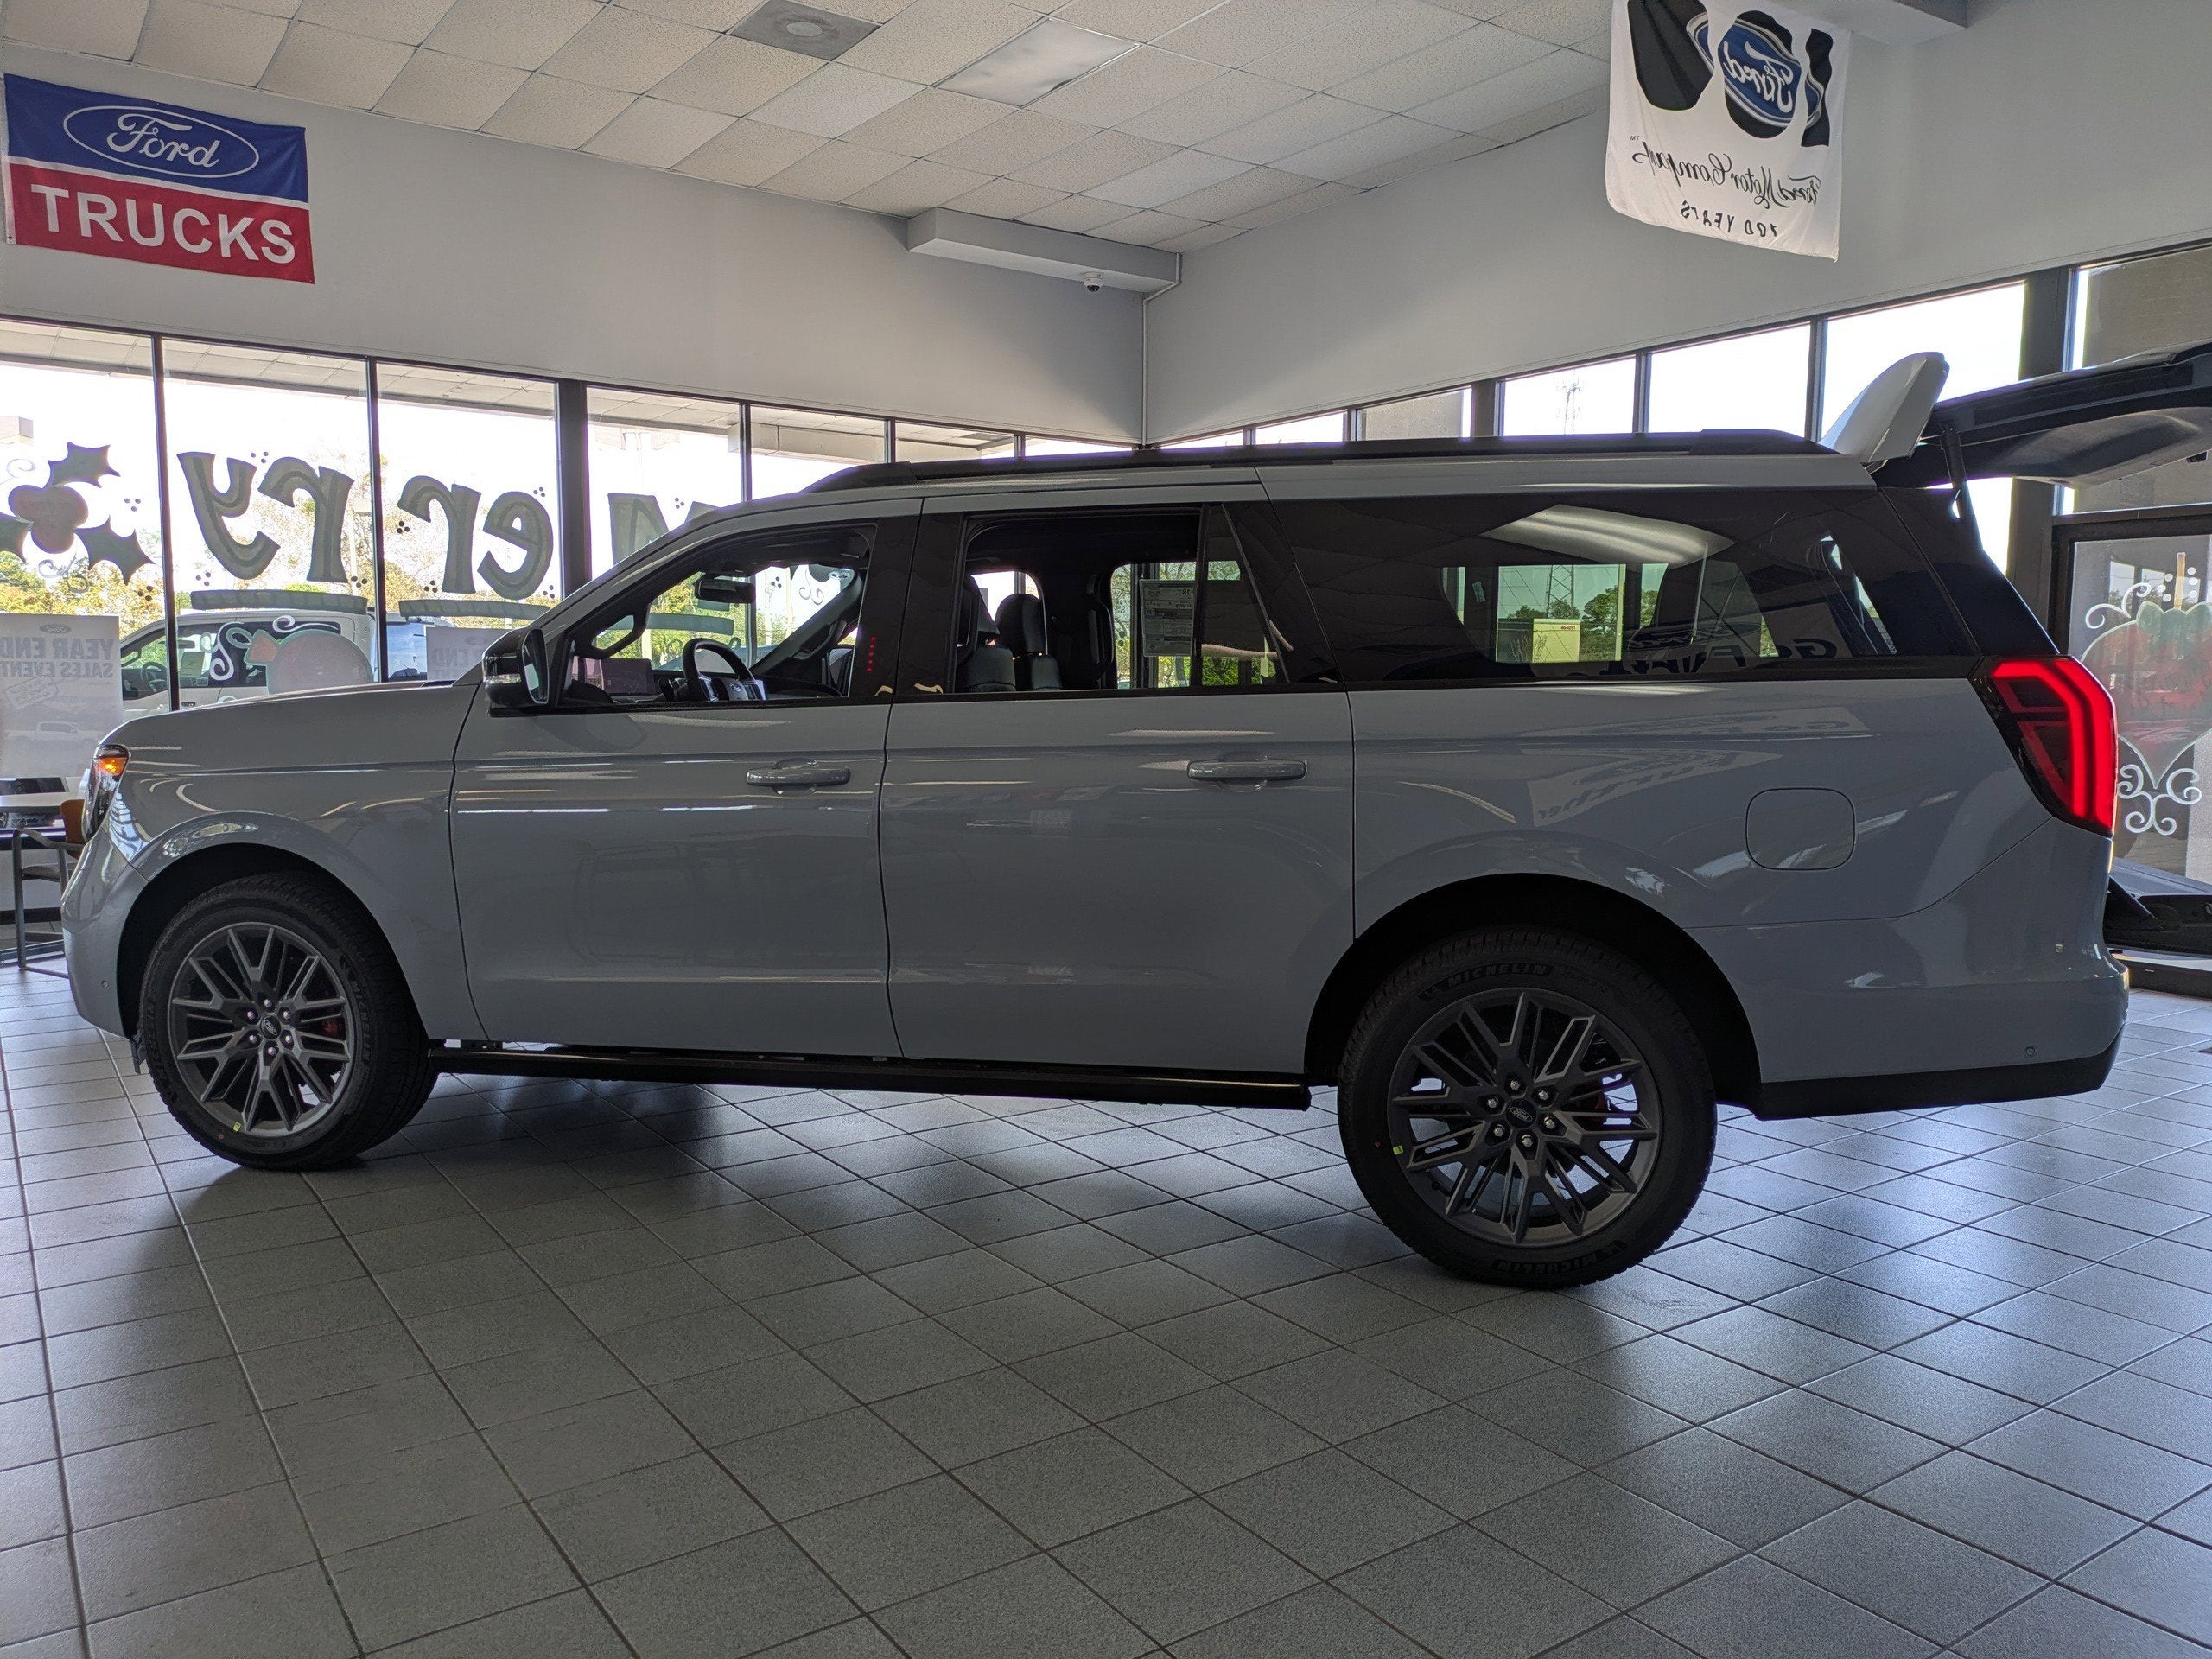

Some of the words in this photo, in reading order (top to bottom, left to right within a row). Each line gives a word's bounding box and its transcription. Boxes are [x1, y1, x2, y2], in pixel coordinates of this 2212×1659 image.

[106, 113, 221, 168] Ford
[31, 184, 296, 264] TRUCKS
[1447, 963, 1548, 988] MICHELIN
